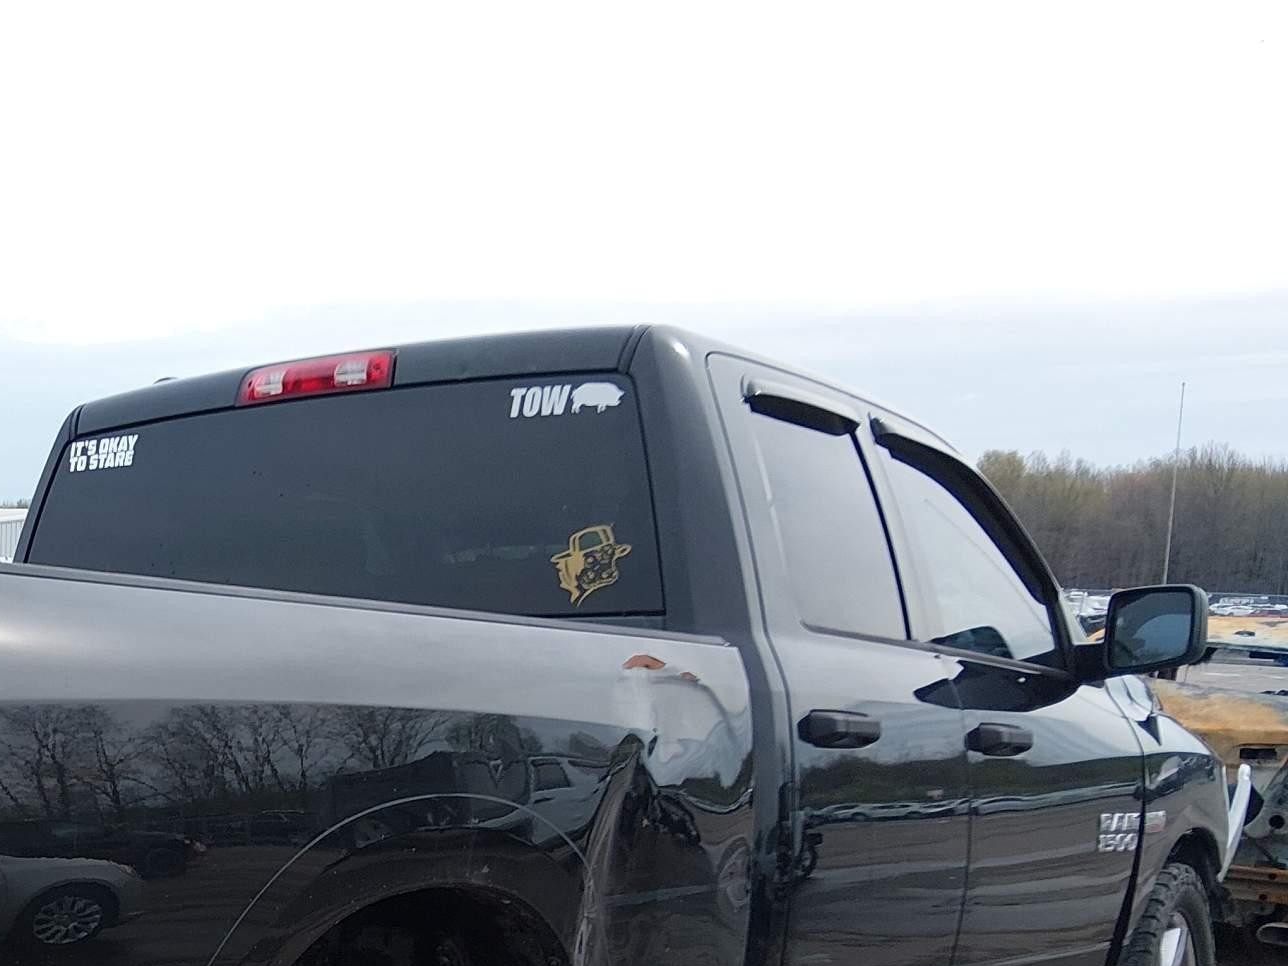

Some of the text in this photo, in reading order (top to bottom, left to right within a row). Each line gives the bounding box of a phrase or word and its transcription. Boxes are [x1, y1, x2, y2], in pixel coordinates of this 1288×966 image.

[510, 384, 572, 418] TOW
[70, 434, 139, 457] IT'S OKAY
[70, 450, 134, 473] TO STARE
